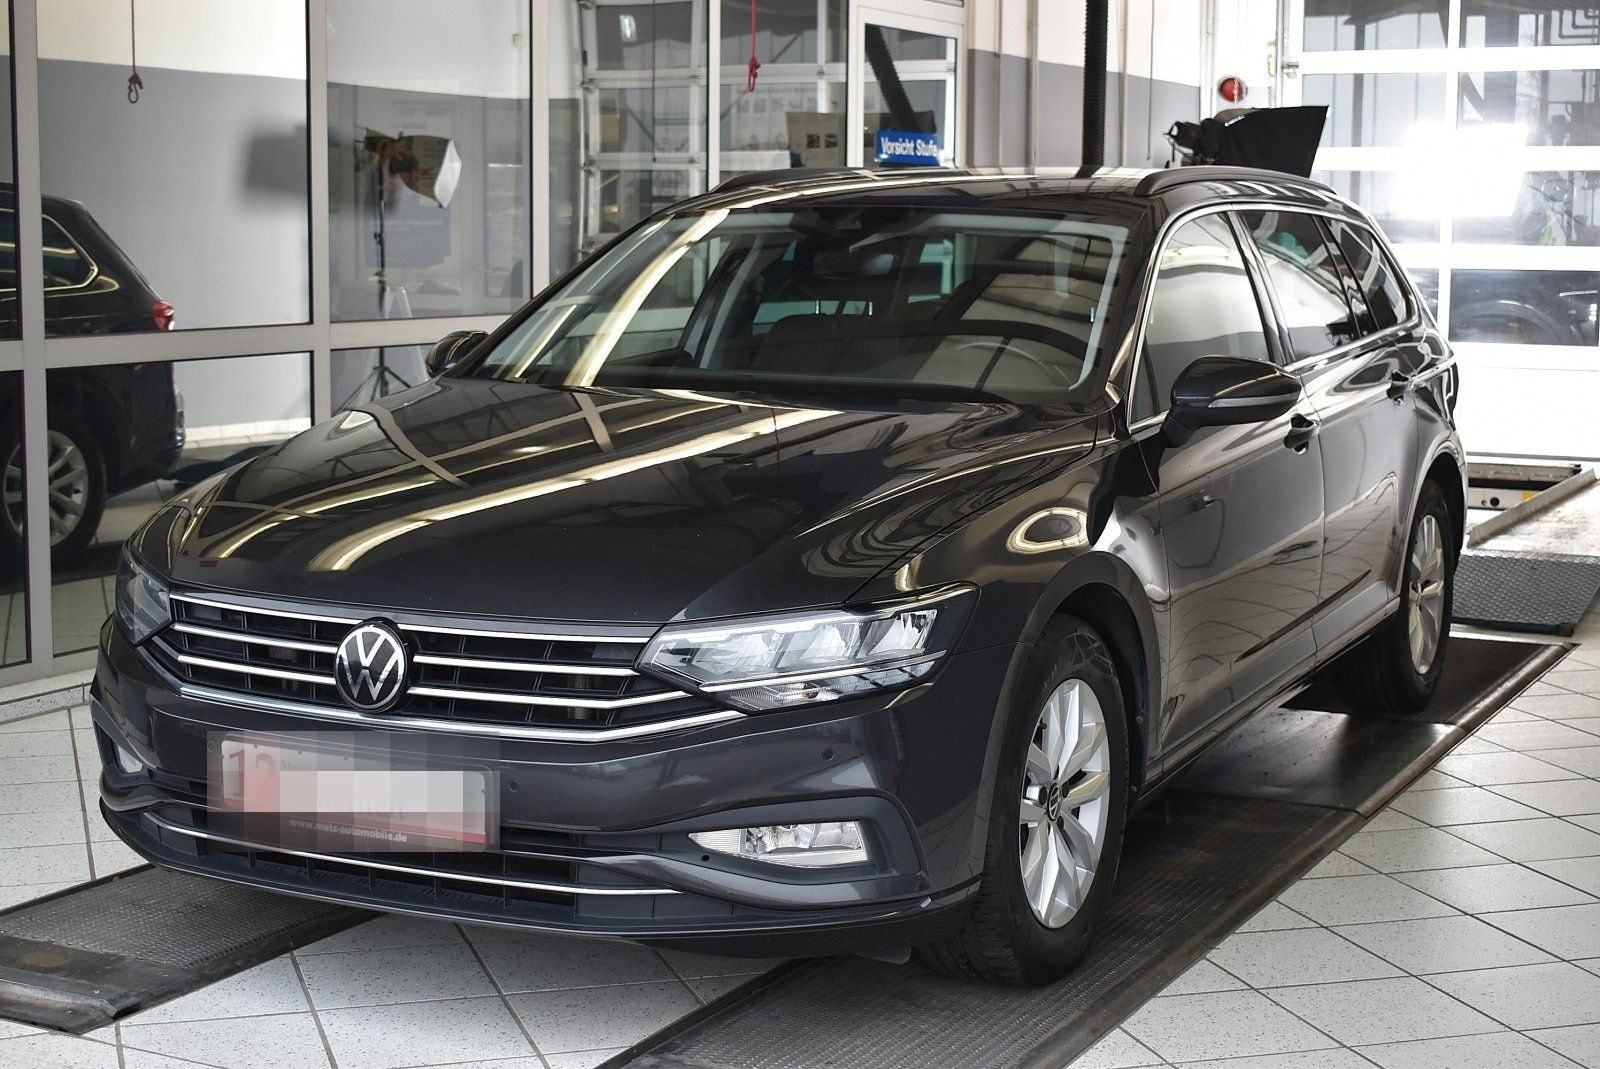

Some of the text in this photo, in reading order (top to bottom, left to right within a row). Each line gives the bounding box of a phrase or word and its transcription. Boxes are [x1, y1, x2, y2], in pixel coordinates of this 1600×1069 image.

[880, 135, 938, 157] Vorsicht Stufe
[340, 630, 400, 701] VW
[289, 818, 408, 842] www.matz-automobile.de
